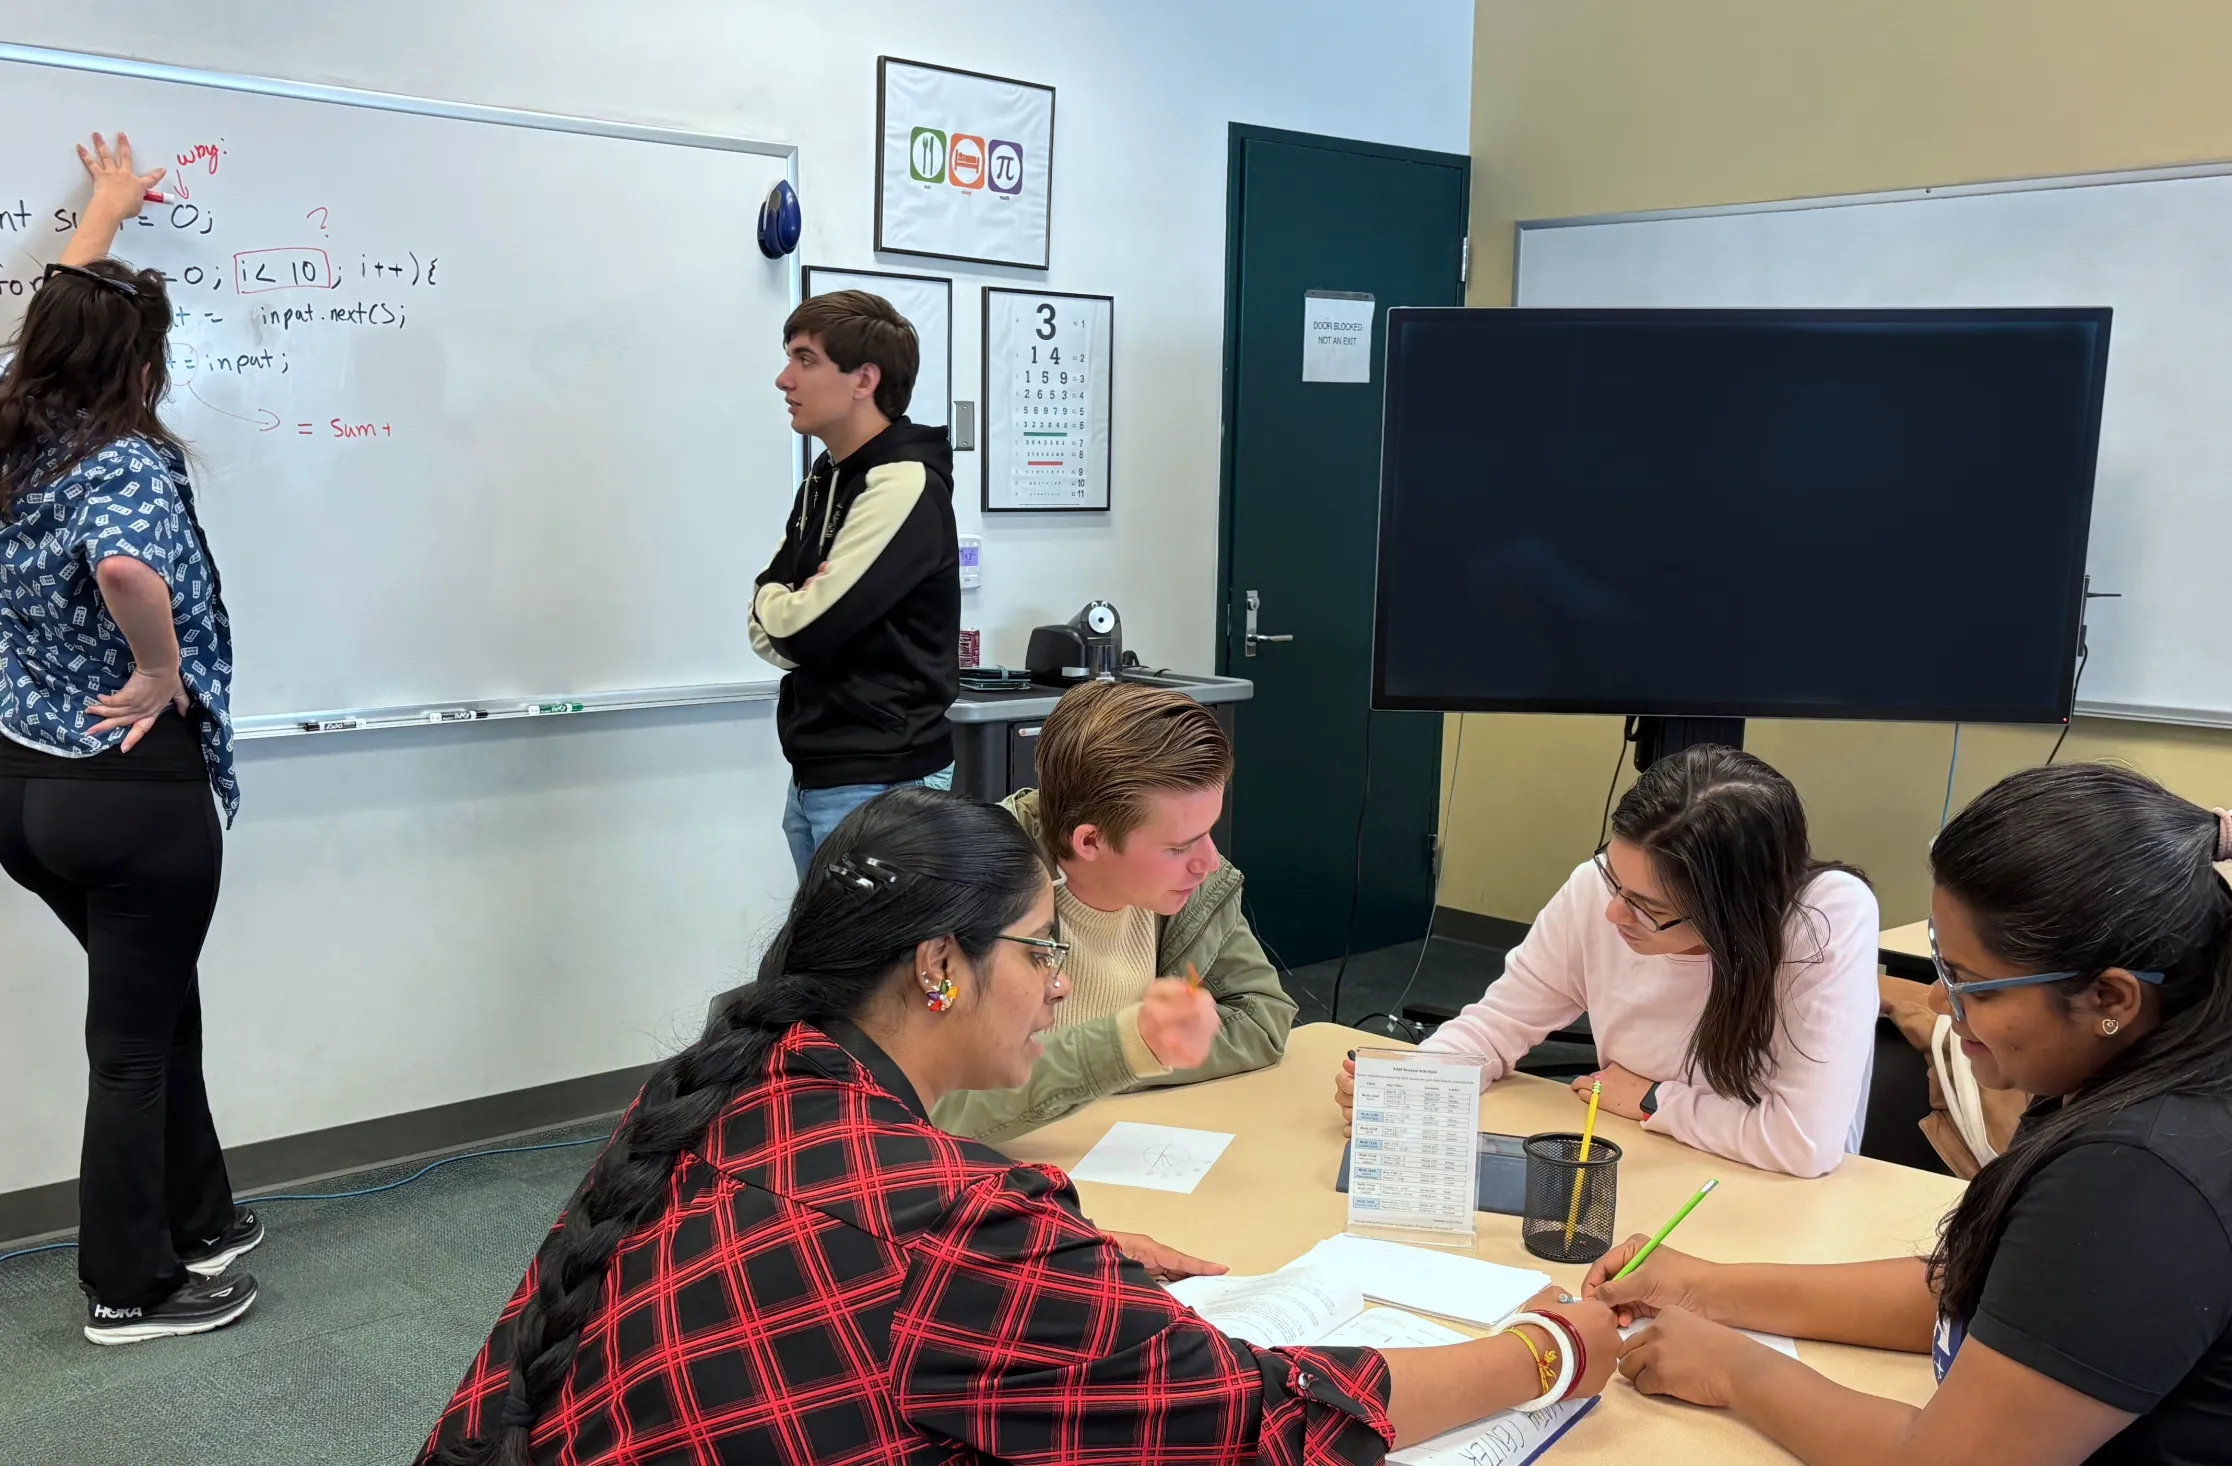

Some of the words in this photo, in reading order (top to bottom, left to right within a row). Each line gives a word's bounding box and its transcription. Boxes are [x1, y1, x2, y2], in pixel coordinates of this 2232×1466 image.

[1036, 303, 1056, 341] 3
[1313, 321, 1332, 329] DOOR
[1333, 322, 1362, 331] BLOCKED
[1318, 336, 1331, 345] NOT
[1332, 336, 1342, 345] AN
[1343, 337, 1357, 345] EXIT
[94, 1303, 143, 1319] HOKA
